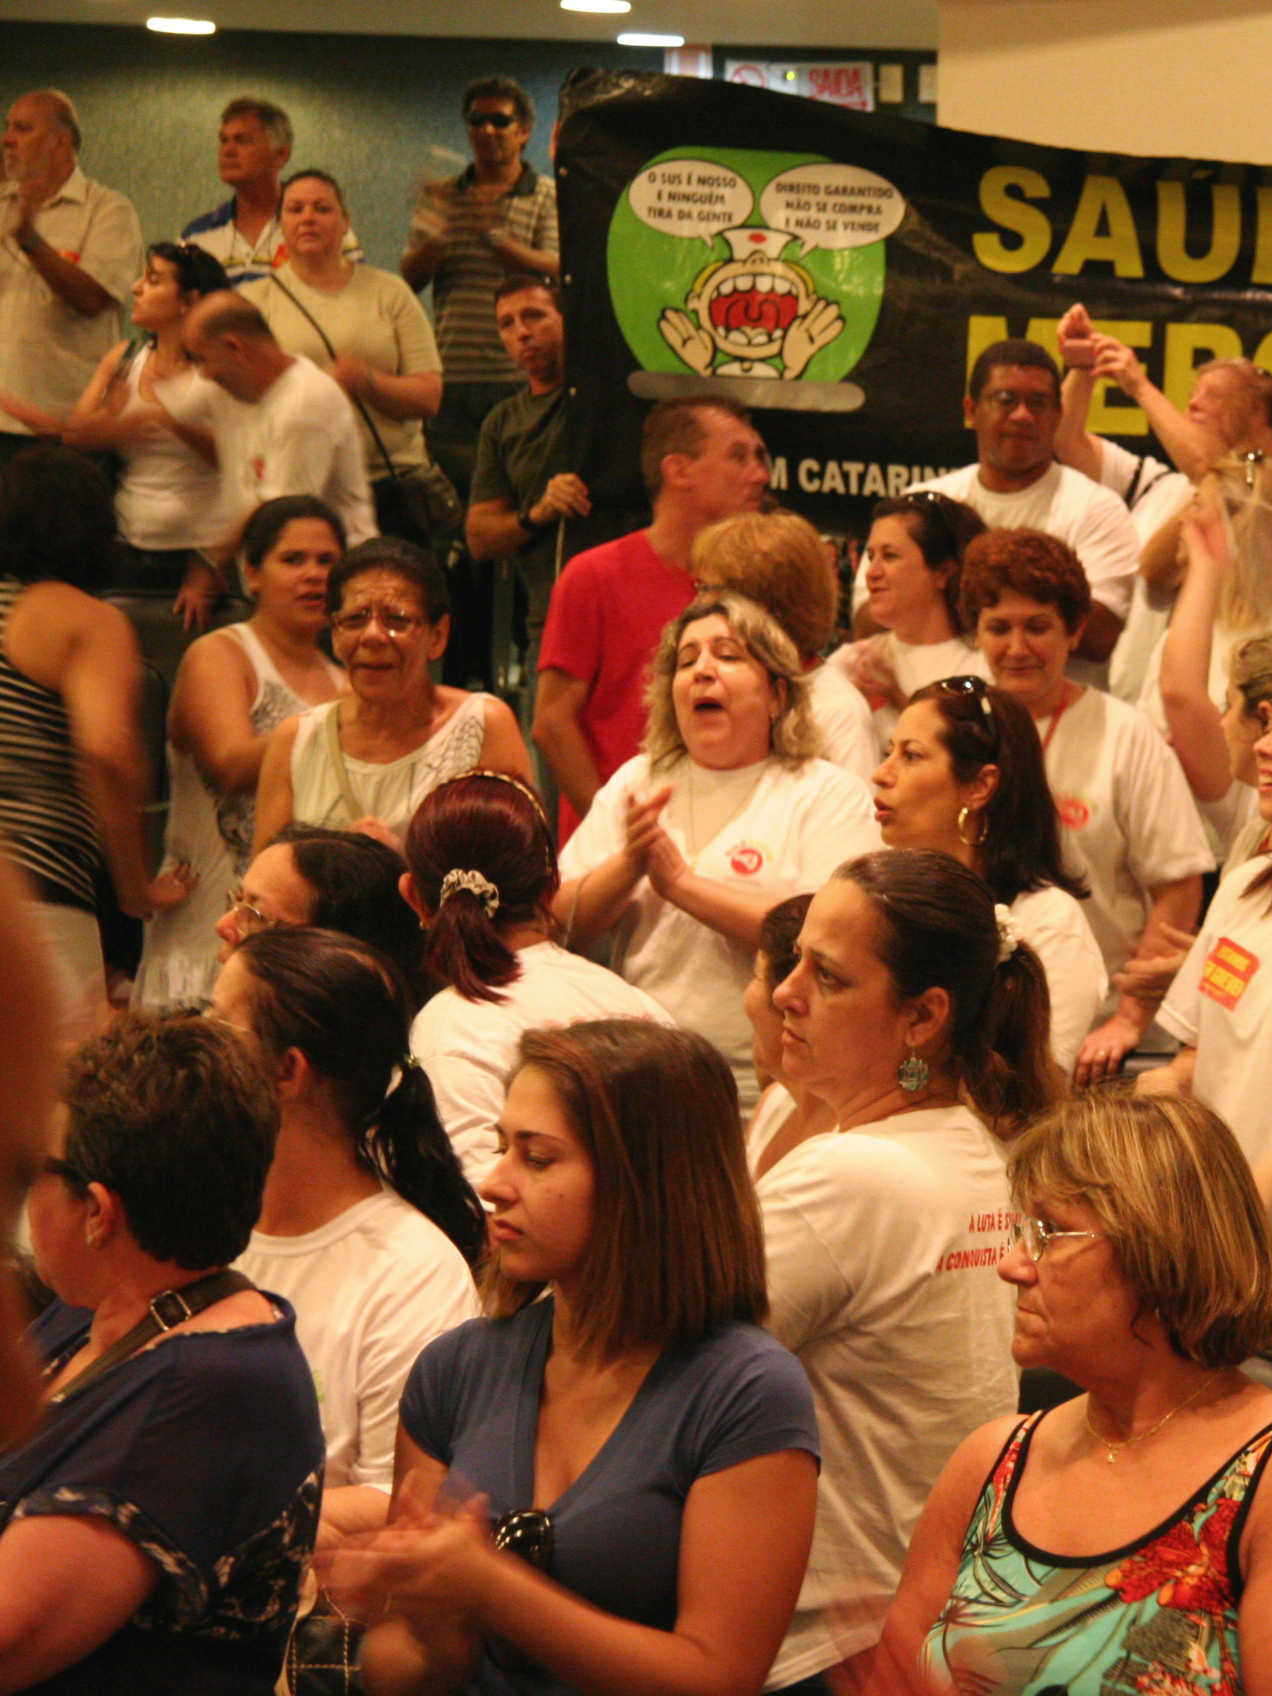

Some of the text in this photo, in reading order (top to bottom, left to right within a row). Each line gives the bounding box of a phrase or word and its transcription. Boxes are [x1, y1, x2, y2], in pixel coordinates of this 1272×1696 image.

[648, 171, 737, 188] O SUS É NOSSO
[657, 189, 725, 205] E NINGUÉM
[775, 182, 894, 199] DIREITO GARANTIDO
[647, 206, 733, 223] TIRA DA GENTE
[785, 199, 883, 215] NÃO SE COMPRA
[785, 217, 881, 234] E NÃO SE VENDE
[969, 1214, 975, 1233] A
[977, 1213, 995, 1232] LUTA
[998, 1208, 1003, 1231] É
[936, 1255, 944, 1273] A
[946, 1247, 997, 1271] CONQUISTA
